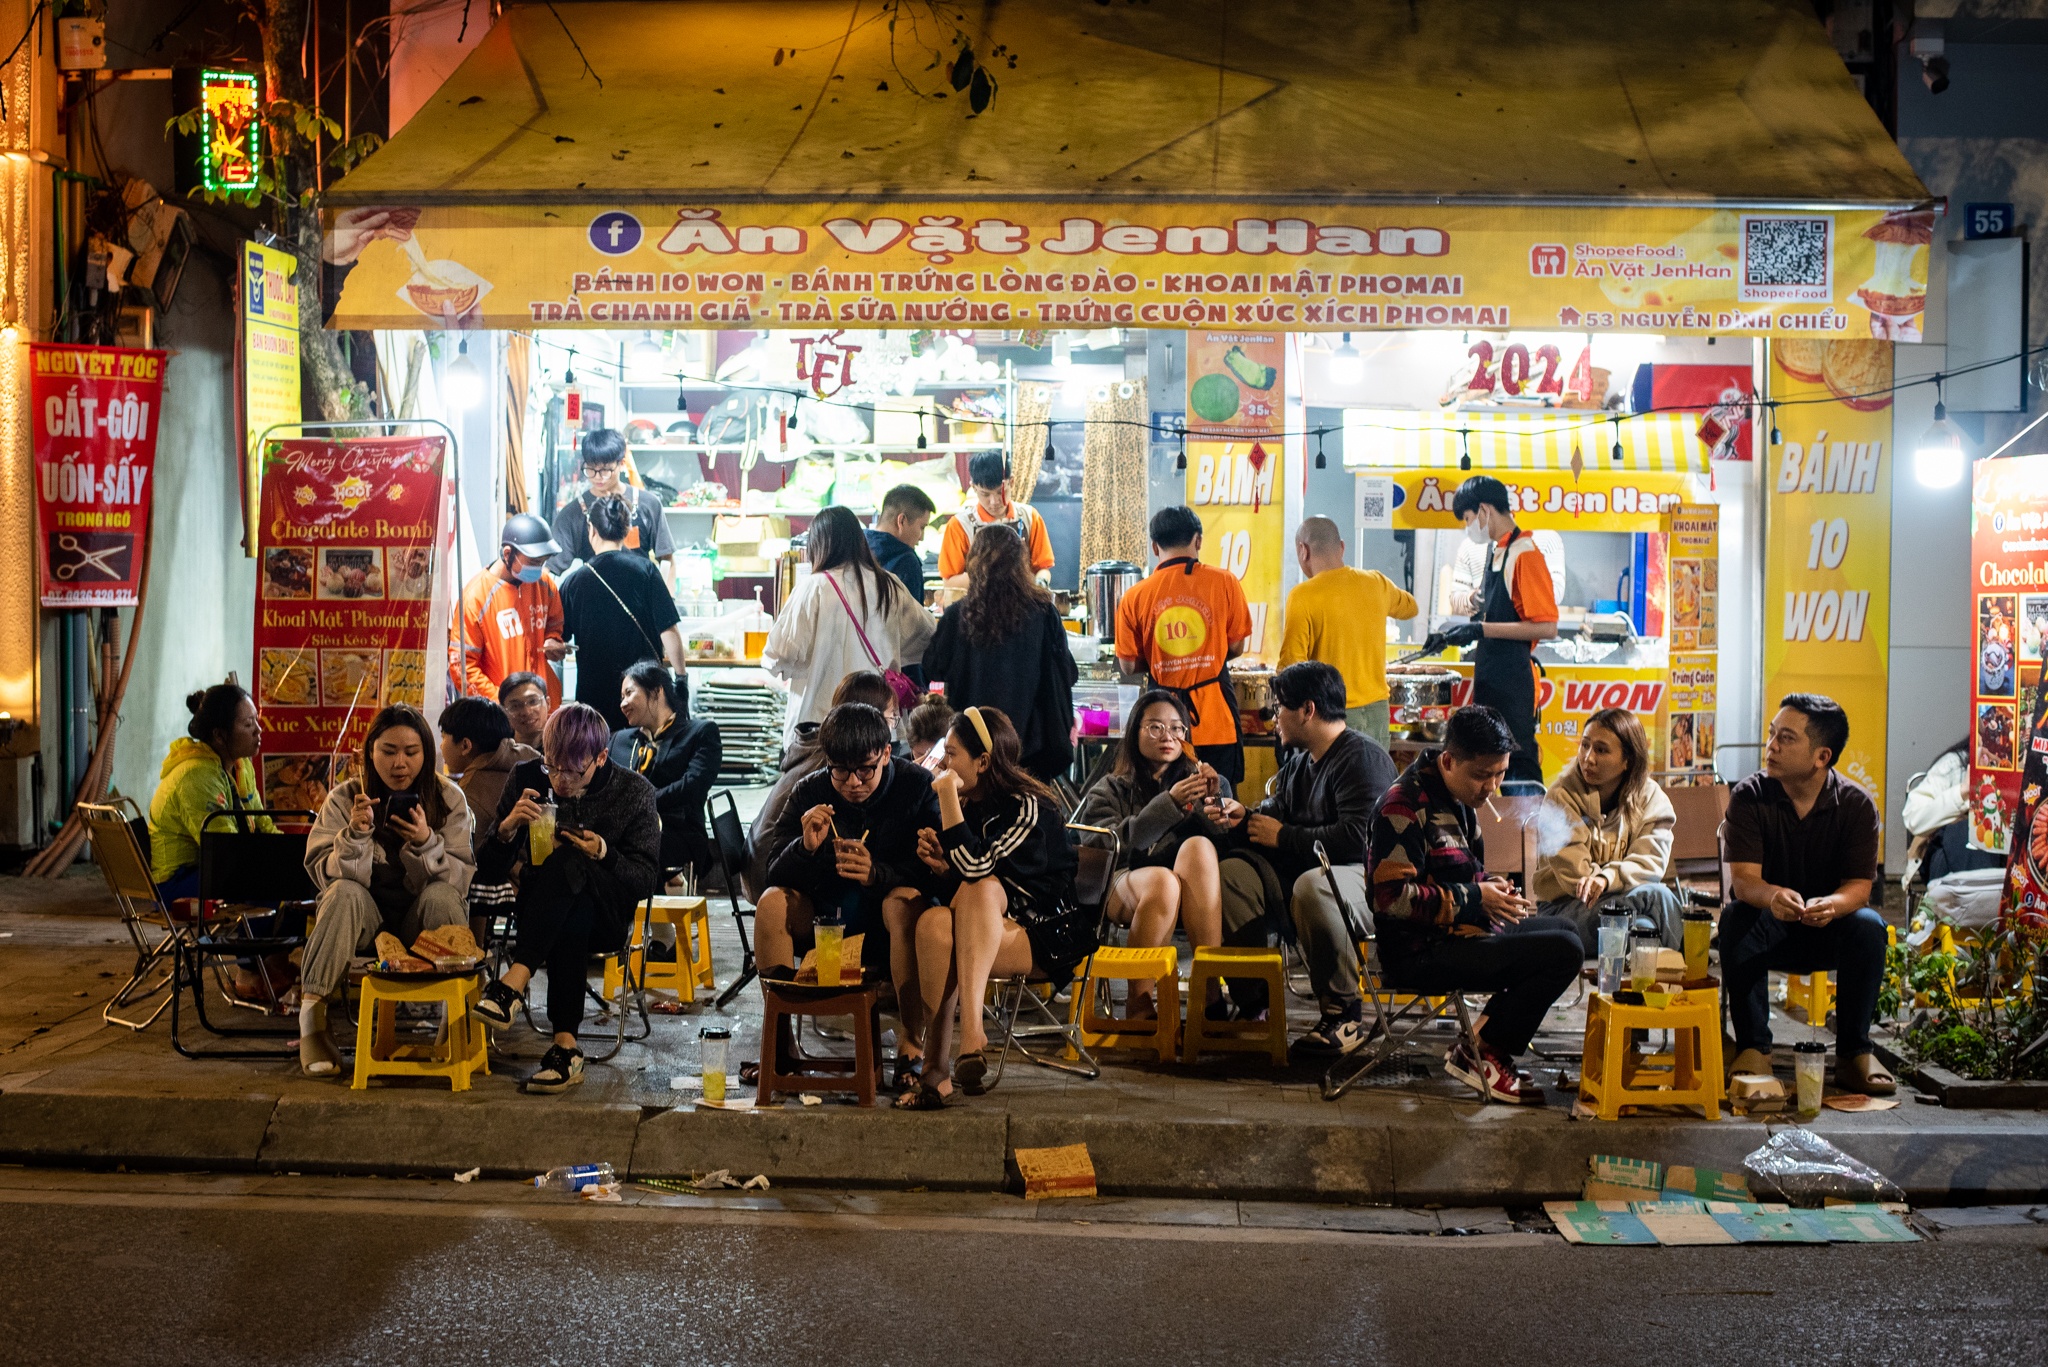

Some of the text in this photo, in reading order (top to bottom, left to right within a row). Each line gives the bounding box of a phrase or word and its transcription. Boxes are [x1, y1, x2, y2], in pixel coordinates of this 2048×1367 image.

[1975, 210, 2004, 233] 55
[657, 207, 1450, 265] Ăn Vặt JenHan
[1574, 244, 1676, 258] ShopeeFood
[1574, 260, 1732, 281] Ăn Vặt JenHan
[575, 268, 654, 293] BÁNH
[697, 273, 764, 292] WON
[790, 268, 872, 293] BÁNH
[880, 268, 974, 293] TRỨNG
[982, 269, 1064, 294] LÒNG
[1070, 268, 1137, 294] ĐÀO
[1162, 273, 1261, 295] KHOAI
[1269, 270, 1332, 299] MẬT
[1340, 275, 1463, 296] PHOMAI
[1744, 287, 1828, 299] ShopeeFood
[531, 296, 584, 322] TRÀ
[590, 303, 693, 322] CHANH
[699, 297, 752, 322] GIÃ
[779, 297, 831, 322] TRÀ
[839, 296, 896, 322] SỮA
[904, 296, 1011, 322] NƯỚNG
[1038, 298, 1135, 323] TRỨNG
[1139, 299, 1228, 326] CUỘN
[1235, 299, 1296, 324] XÚC
[1304, 299, 1379, 325] XÍCH
[1385, 304, 1510, 326] PHOMAI
[1586, 306, 1848, 331] 53 NGUYỄN ĐÌNH CHIỂU
[1240, 334, 1275, 343] JenHan
[36, 349, 158, 380] NGUYỆT TÓC
[789, 329, 862, 397] TẾT
[1468, 340, 1593, 401] 2024
[45, 384, 149, 449] CẮT-GỘI
[285, 450, 337, 475] Merry
[1195, 442, 1277, 505] BÁNH
[1777, 430, 1882, 494] BÁNH
[42, 451, 148, 505] UỐN-SẤY
[334, 484, 373, 499] HOOT
[1543, 485, 1607, 514] Jen
[56, 509, 131, 528] TRONG NGÕ
[271, 518, 433, 539] Chocolate Bomb
[1673, 520, 1699, 532] KHOAI
[1220, 529, 1251, 581] 10
[1807, 517, 1849, 571] 10
[262, 609, 305, 628] Khoai
[310, 609, 344, 630] Mật
[1782, 589, 1871, 642] WON
[311, 633, 340, 646] Siêu
[343, 633, 367, 646] Kéo
[1164, 620, 1188, 641] 10
[1563, 680, 1666, 714] WON
[260, 715, 300, 733] Xúc
[2023, 786, 2042, 802] HOOT
[2010, 864, 2029, 888] HOOT
[2034, 894, 2046, 911] Ăn
